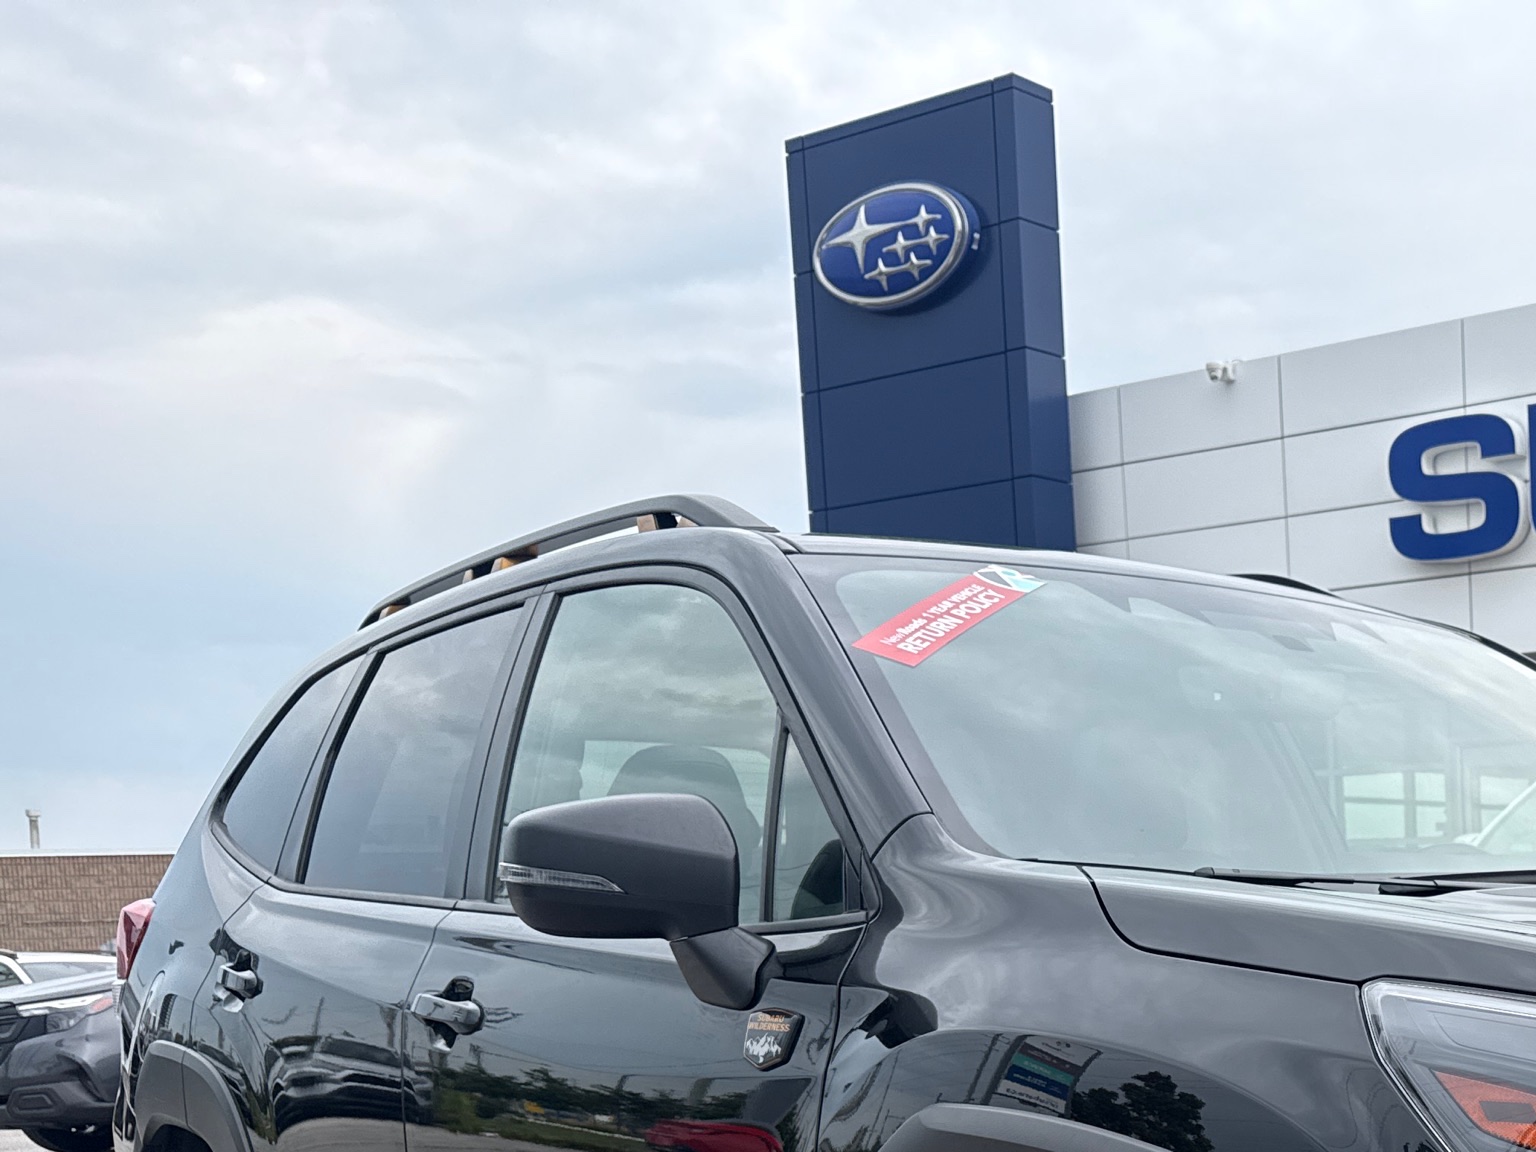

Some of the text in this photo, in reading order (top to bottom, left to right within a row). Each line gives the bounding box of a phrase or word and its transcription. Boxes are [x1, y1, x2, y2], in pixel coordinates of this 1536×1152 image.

[927, 600, 956, 615] YEAR
[947, 584, 986, 604] VEHICLE
[896, 588, 1006, 654] RETURN POLICY
[748, 1021, 790, 1032] WILDERNESS
[757, 1014, 786, 1022] SUBARU
